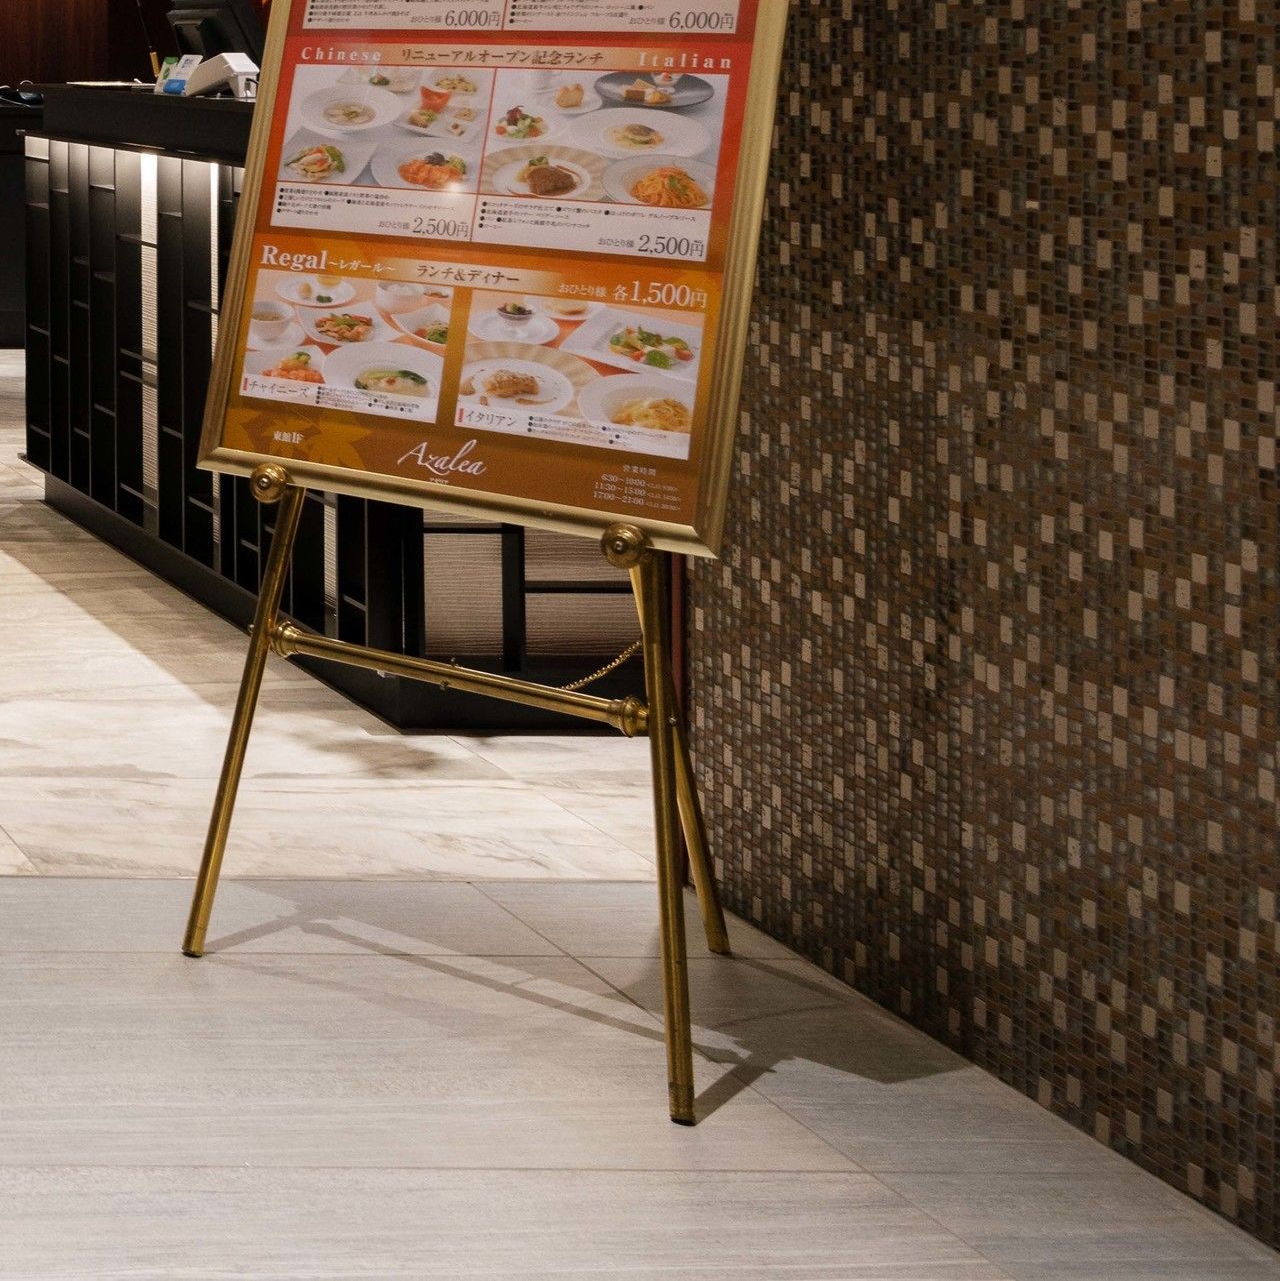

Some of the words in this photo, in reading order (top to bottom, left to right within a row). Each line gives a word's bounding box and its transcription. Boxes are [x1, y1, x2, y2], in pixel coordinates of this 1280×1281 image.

[300, 46, 382, 62] Chinese
[401, 48, 604, 65] リニューアルオープン記念ランチ
[639, 51, 732, 69] Italian
[260, 244, 328, 271] Regal
[396, 438, 488, 476] Azalea
